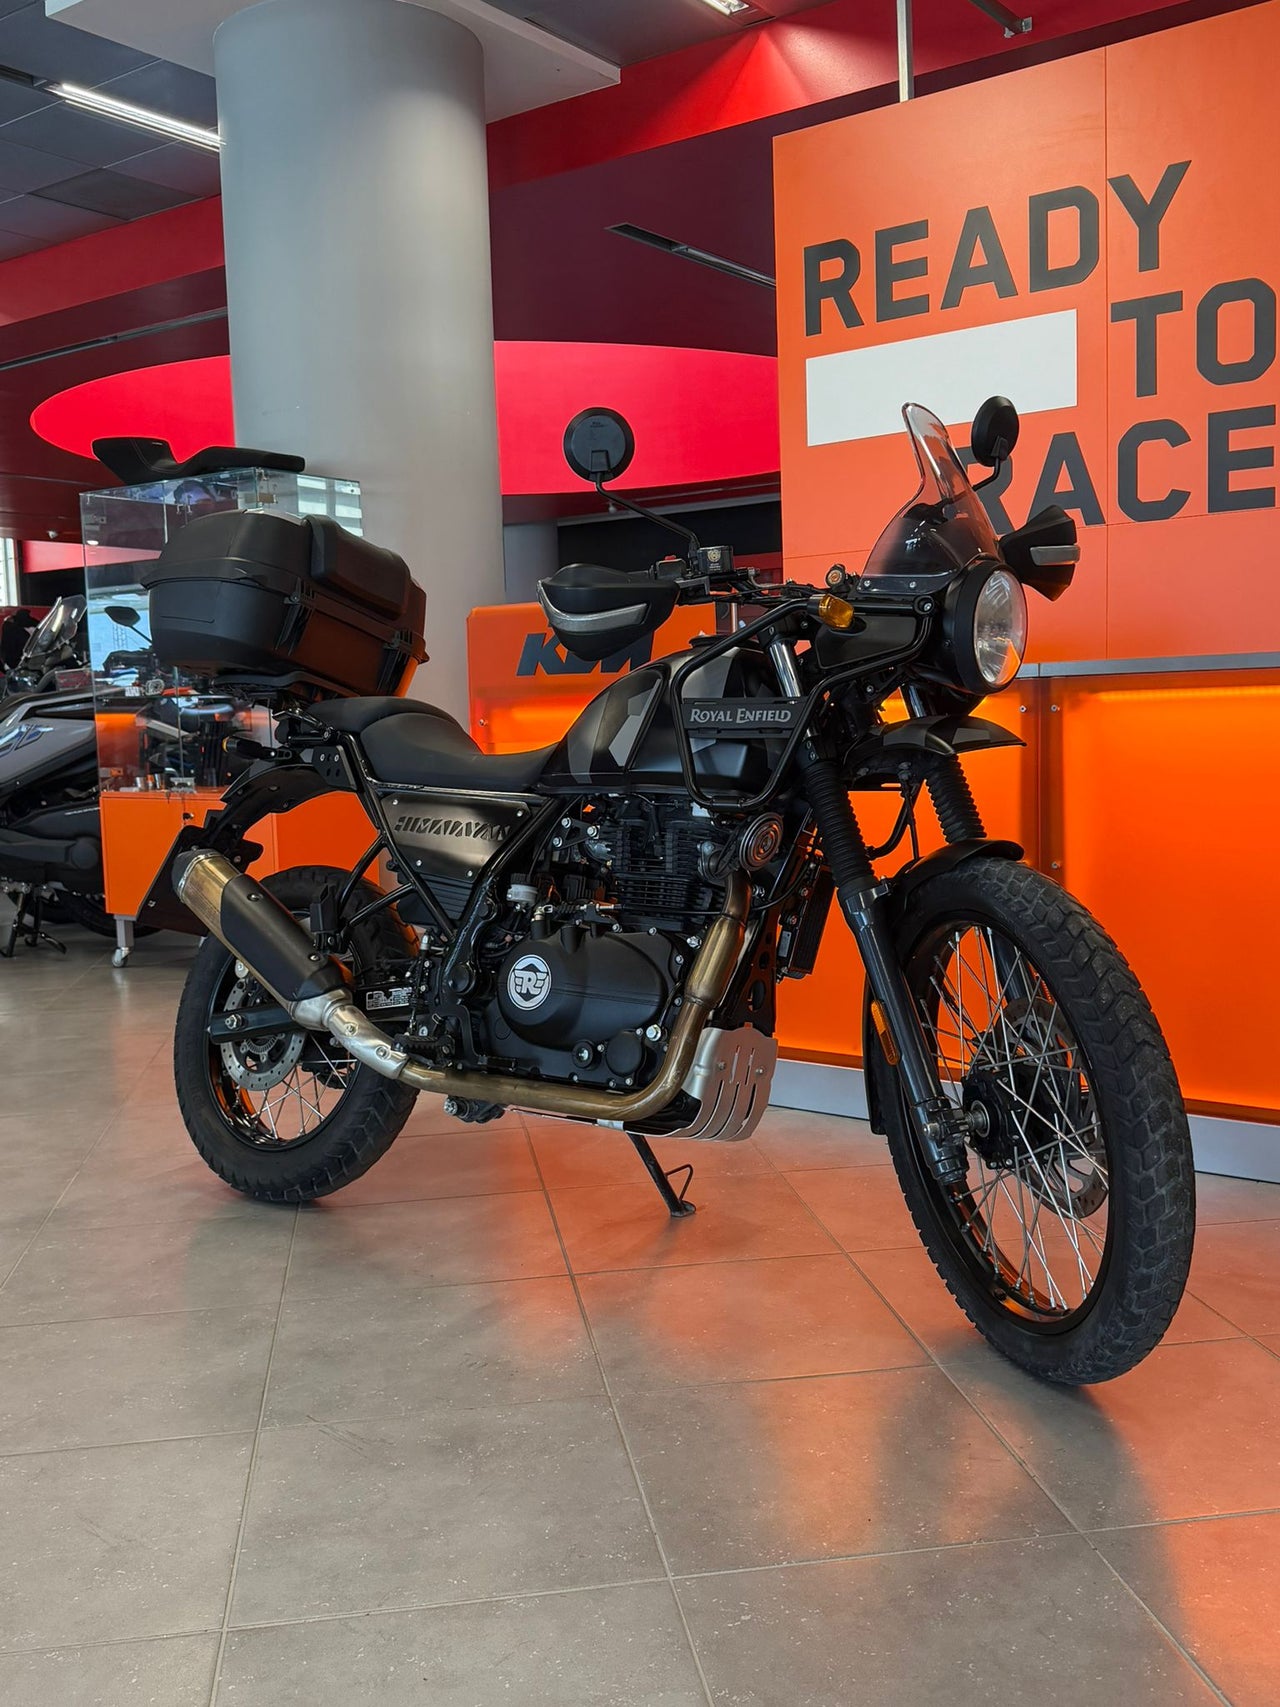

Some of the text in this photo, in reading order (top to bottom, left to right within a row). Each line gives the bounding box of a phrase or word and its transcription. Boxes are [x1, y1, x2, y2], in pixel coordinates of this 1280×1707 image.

[804, 160, 1192, 337] READY
[1110, 277, 1277, 398] TO
[943, 404, 1276, 536] RACE
[516, 631, 653, 676] KM
[690, 708, 791, 723] ROYAL ENFIELD
[394, 815, 512, 841] HIMALAYAN
